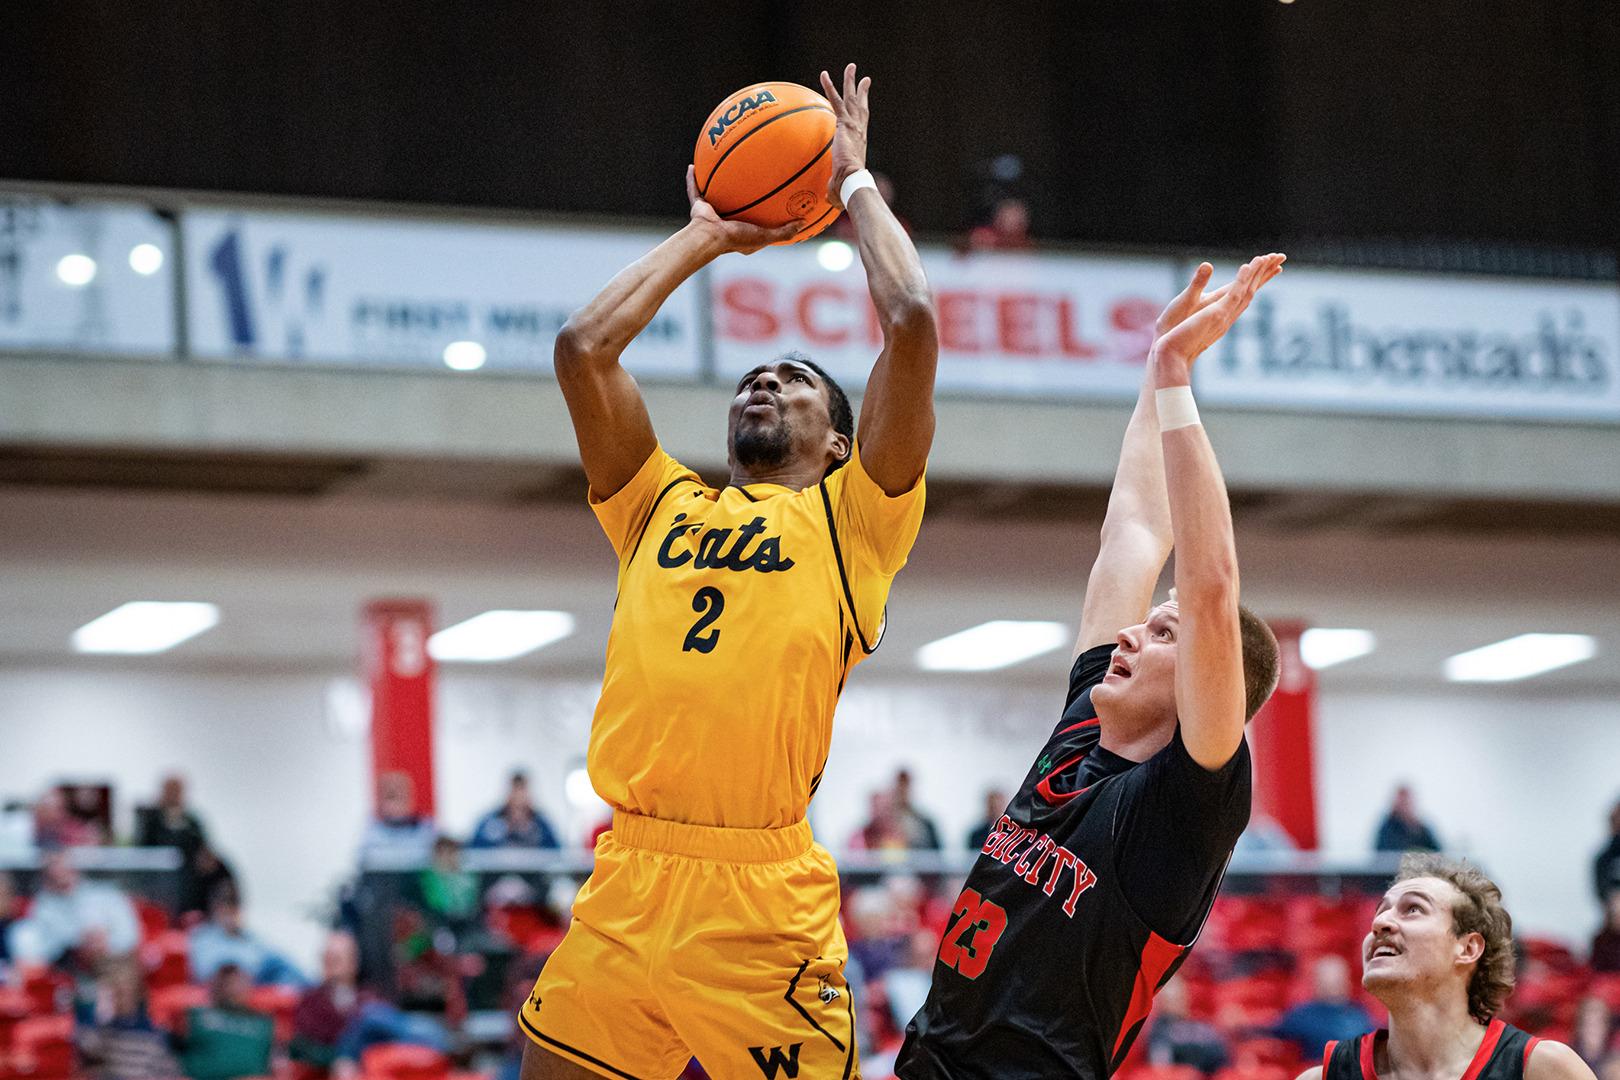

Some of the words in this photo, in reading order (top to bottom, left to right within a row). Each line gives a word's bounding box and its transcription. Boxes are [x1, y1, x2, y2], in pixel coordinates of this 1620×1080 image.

[708, 90, 777, 147] NCAA
[657, 513, 796, 573] Cats
[682, 586, 725, 654] 2
[1013, 833, 1098, 919] CITY
[938, 886, 1009, 981] 23
[747, 1041, 804, 1080] W
